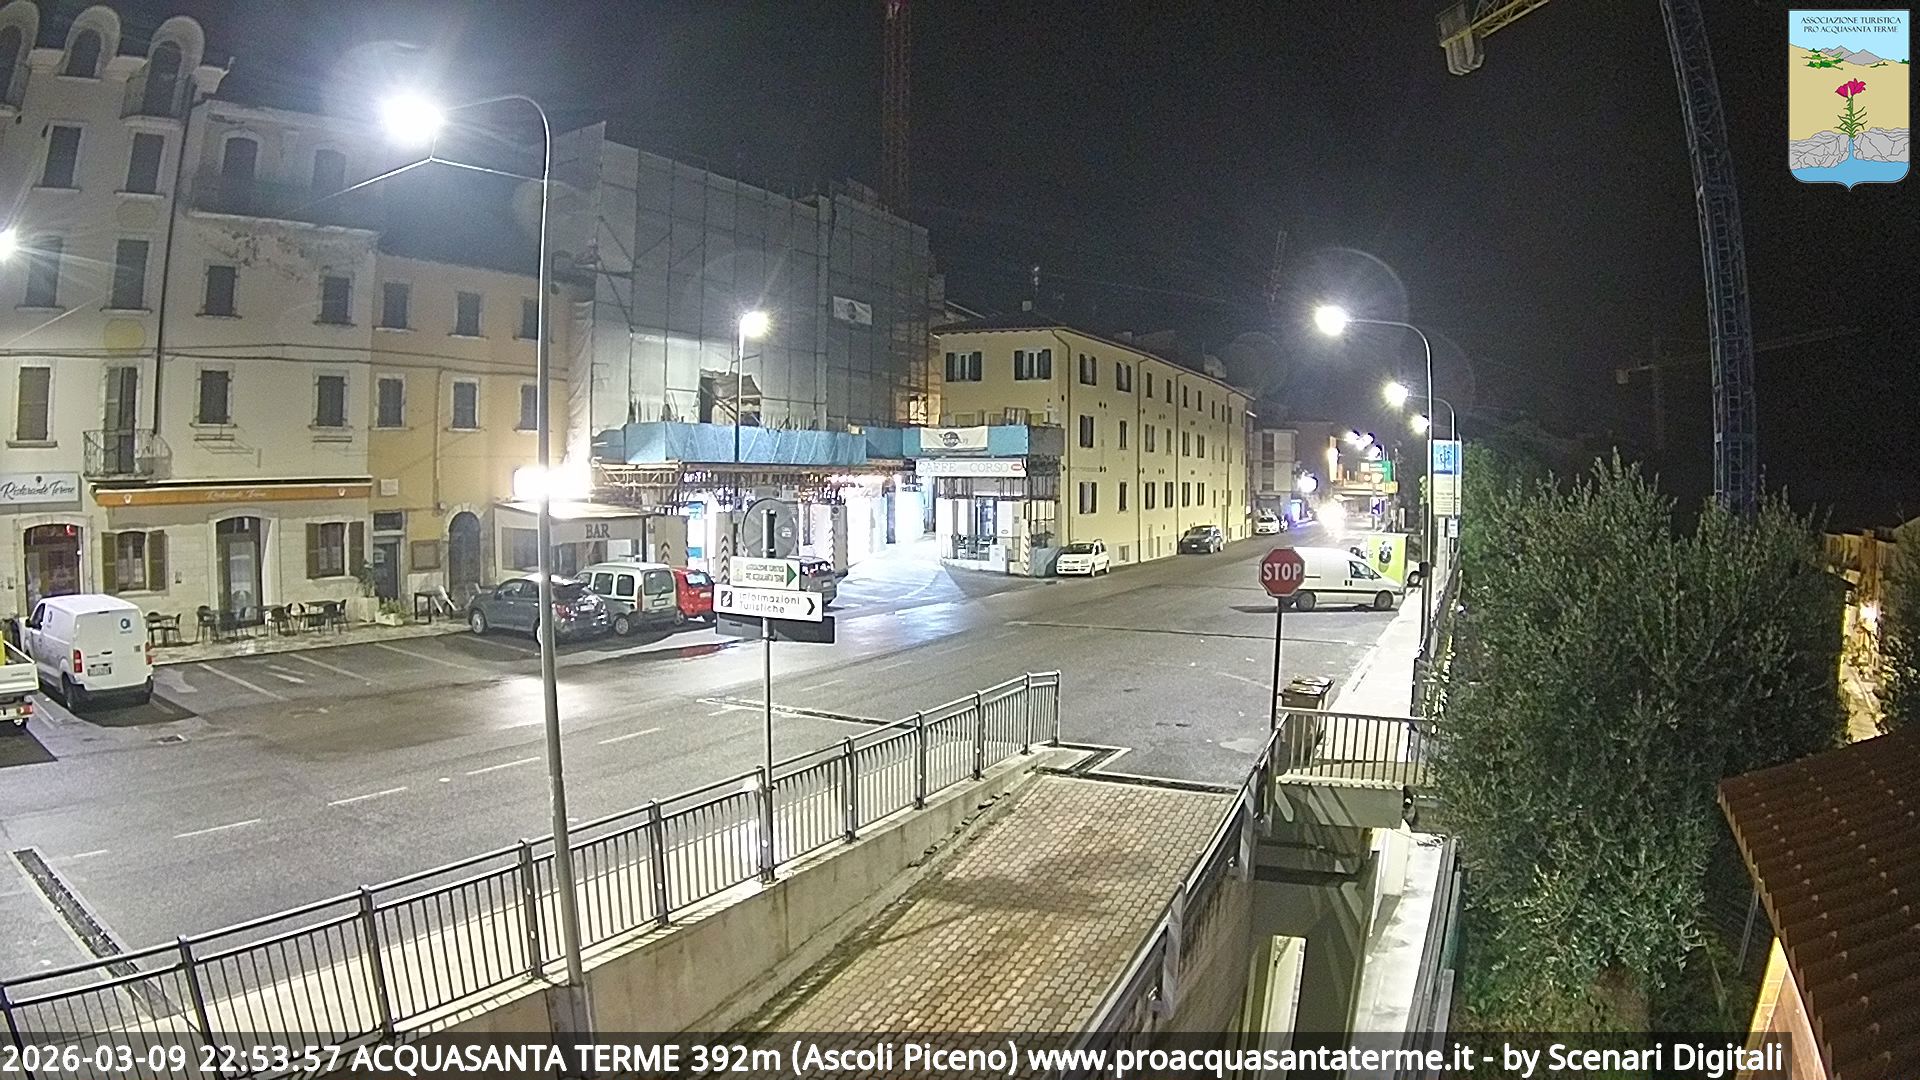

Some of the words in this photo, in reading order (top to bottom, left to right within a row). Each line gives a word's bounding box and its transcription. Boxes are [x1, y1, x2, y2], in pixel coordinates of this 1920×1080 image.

[969, 462, 1009, 473] CORSO
[585, 523, 610, 539] BAR
[1263, 562, 1302, 581] STOP
